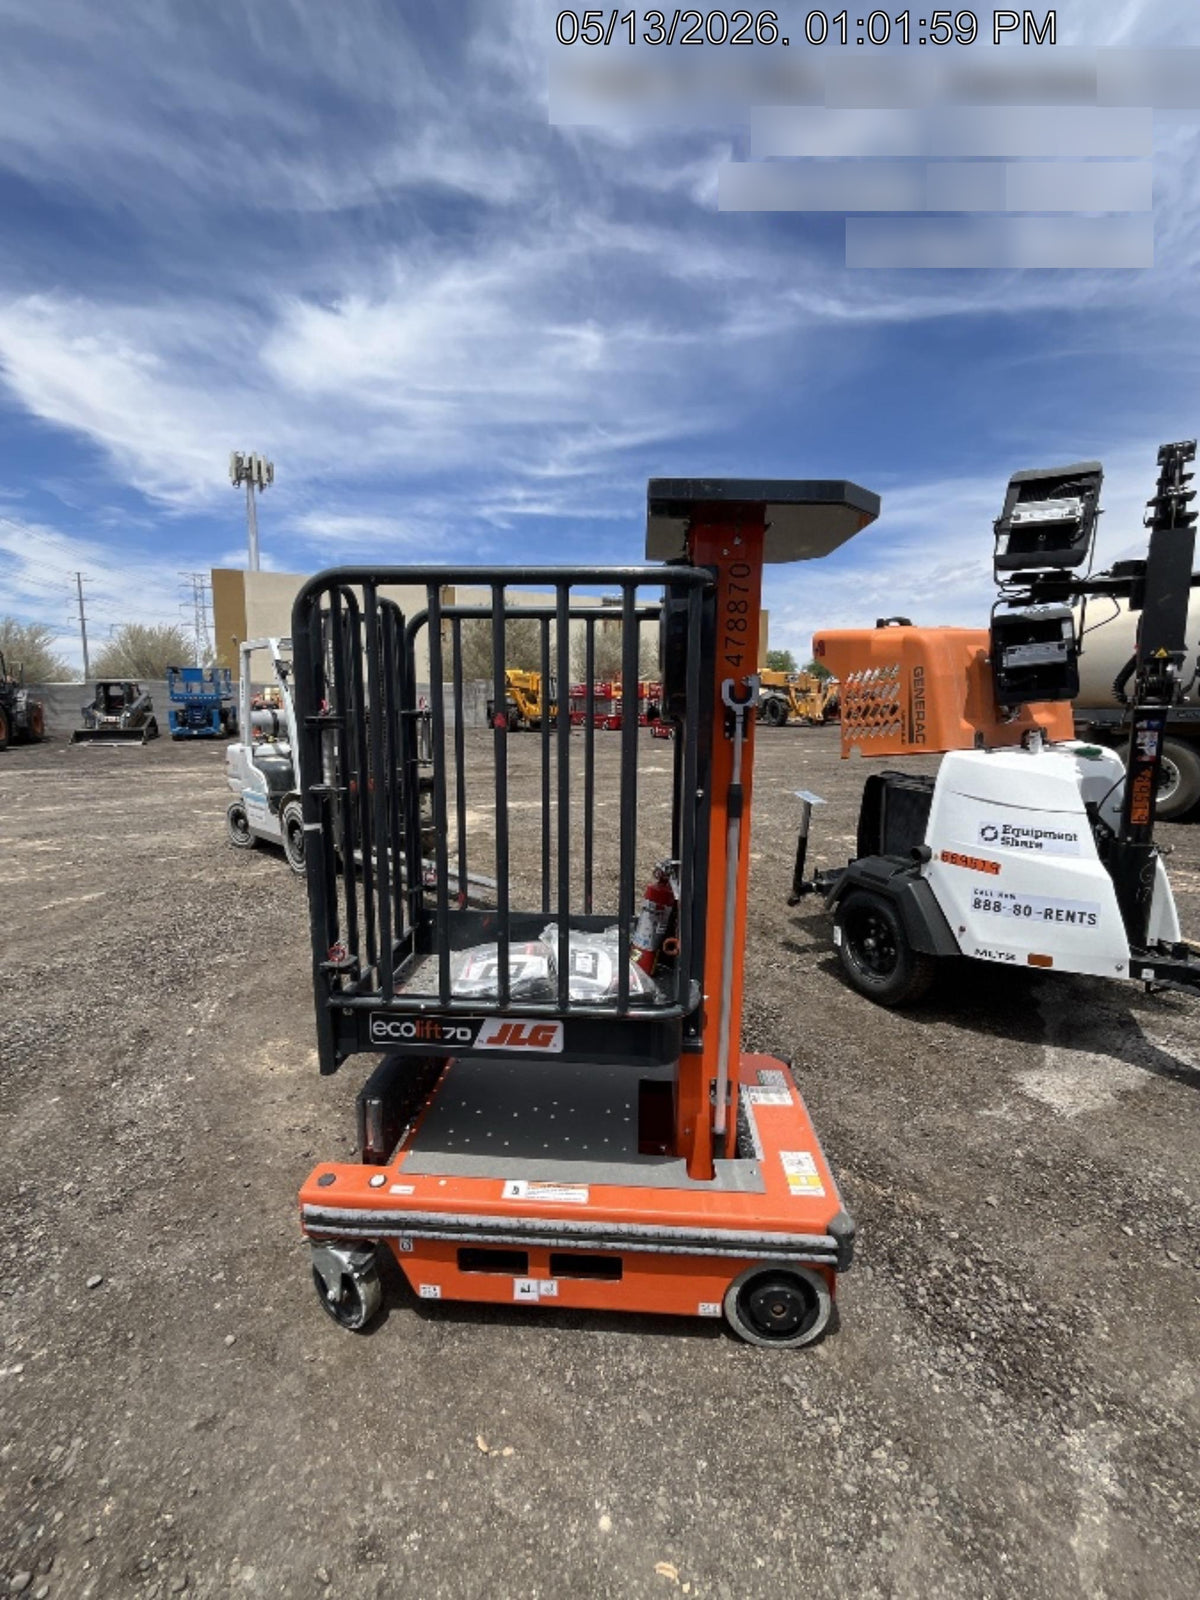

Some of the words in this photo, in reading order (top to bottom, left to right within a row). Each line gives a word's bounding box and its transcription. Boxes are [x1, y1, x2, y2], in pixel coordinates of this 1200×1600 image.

[724, 562, 752, 667] 478870
[913, 665, 927, 746] GENERAC
[1000, 836, 1043, 850] Share
[1001, 824, 1078, 842] Equipment
[372, 1019, 473, 1042] ecolift70
[485, 1022, 560, 1048] JLG
